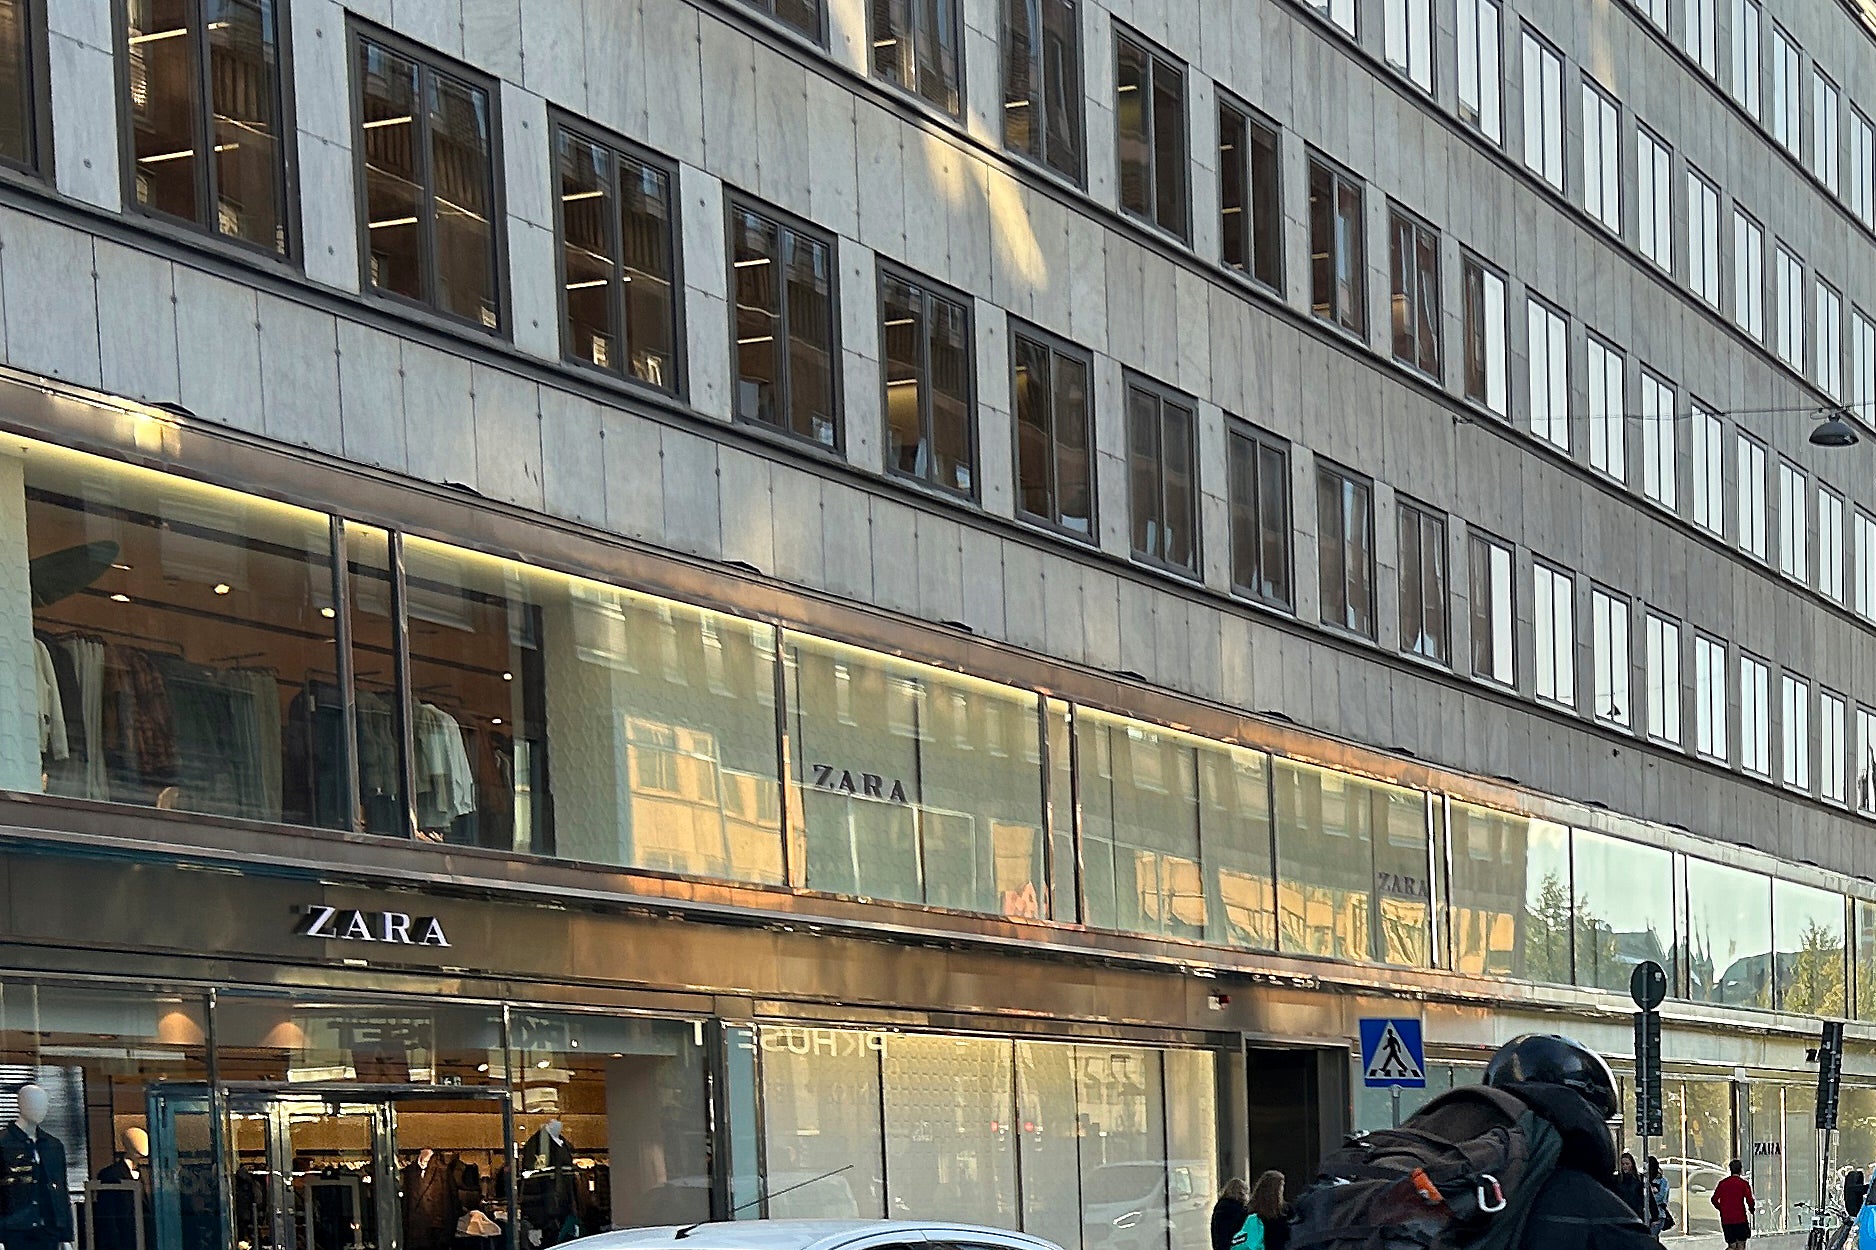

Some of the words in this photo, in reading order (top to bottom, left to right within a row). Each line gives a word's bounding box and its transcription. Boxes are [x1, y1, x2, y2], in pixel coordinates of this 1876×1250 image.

[812, 763, 909, 803] ZARA
[1378, 871, 1429, 897] ZARA
[306, 903, 452, 947] ZARA
[1753, 1142, 1782, 1155] ZARA
